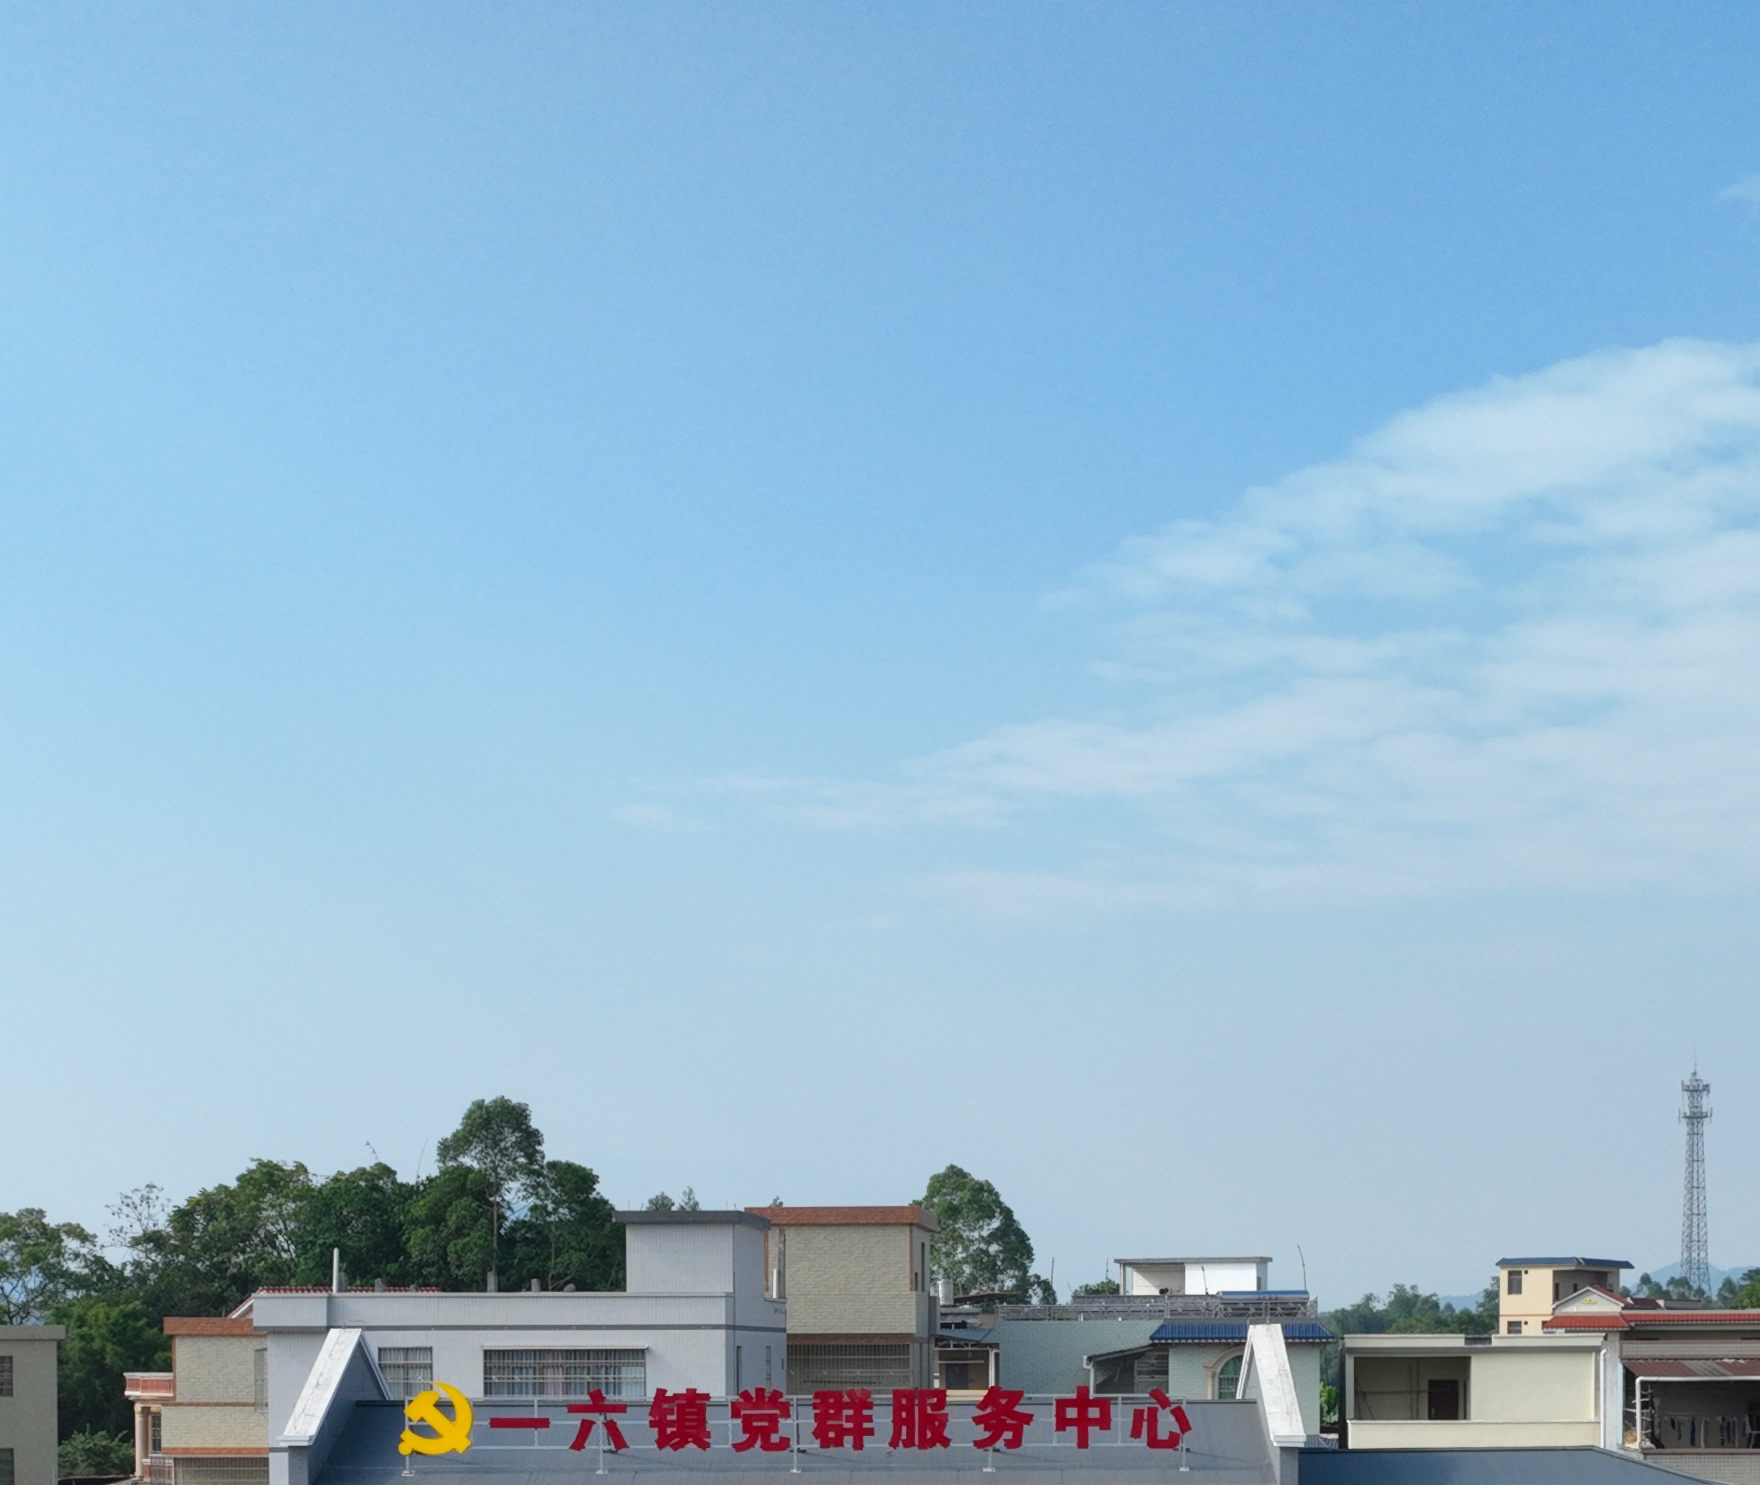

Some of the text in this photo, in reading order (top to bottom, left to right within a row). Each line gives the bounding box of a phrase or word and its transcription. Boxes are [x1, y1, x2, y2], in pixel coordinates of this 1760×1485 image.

[489, 1386, 1193, 1453] 一六镇党群服务中心
